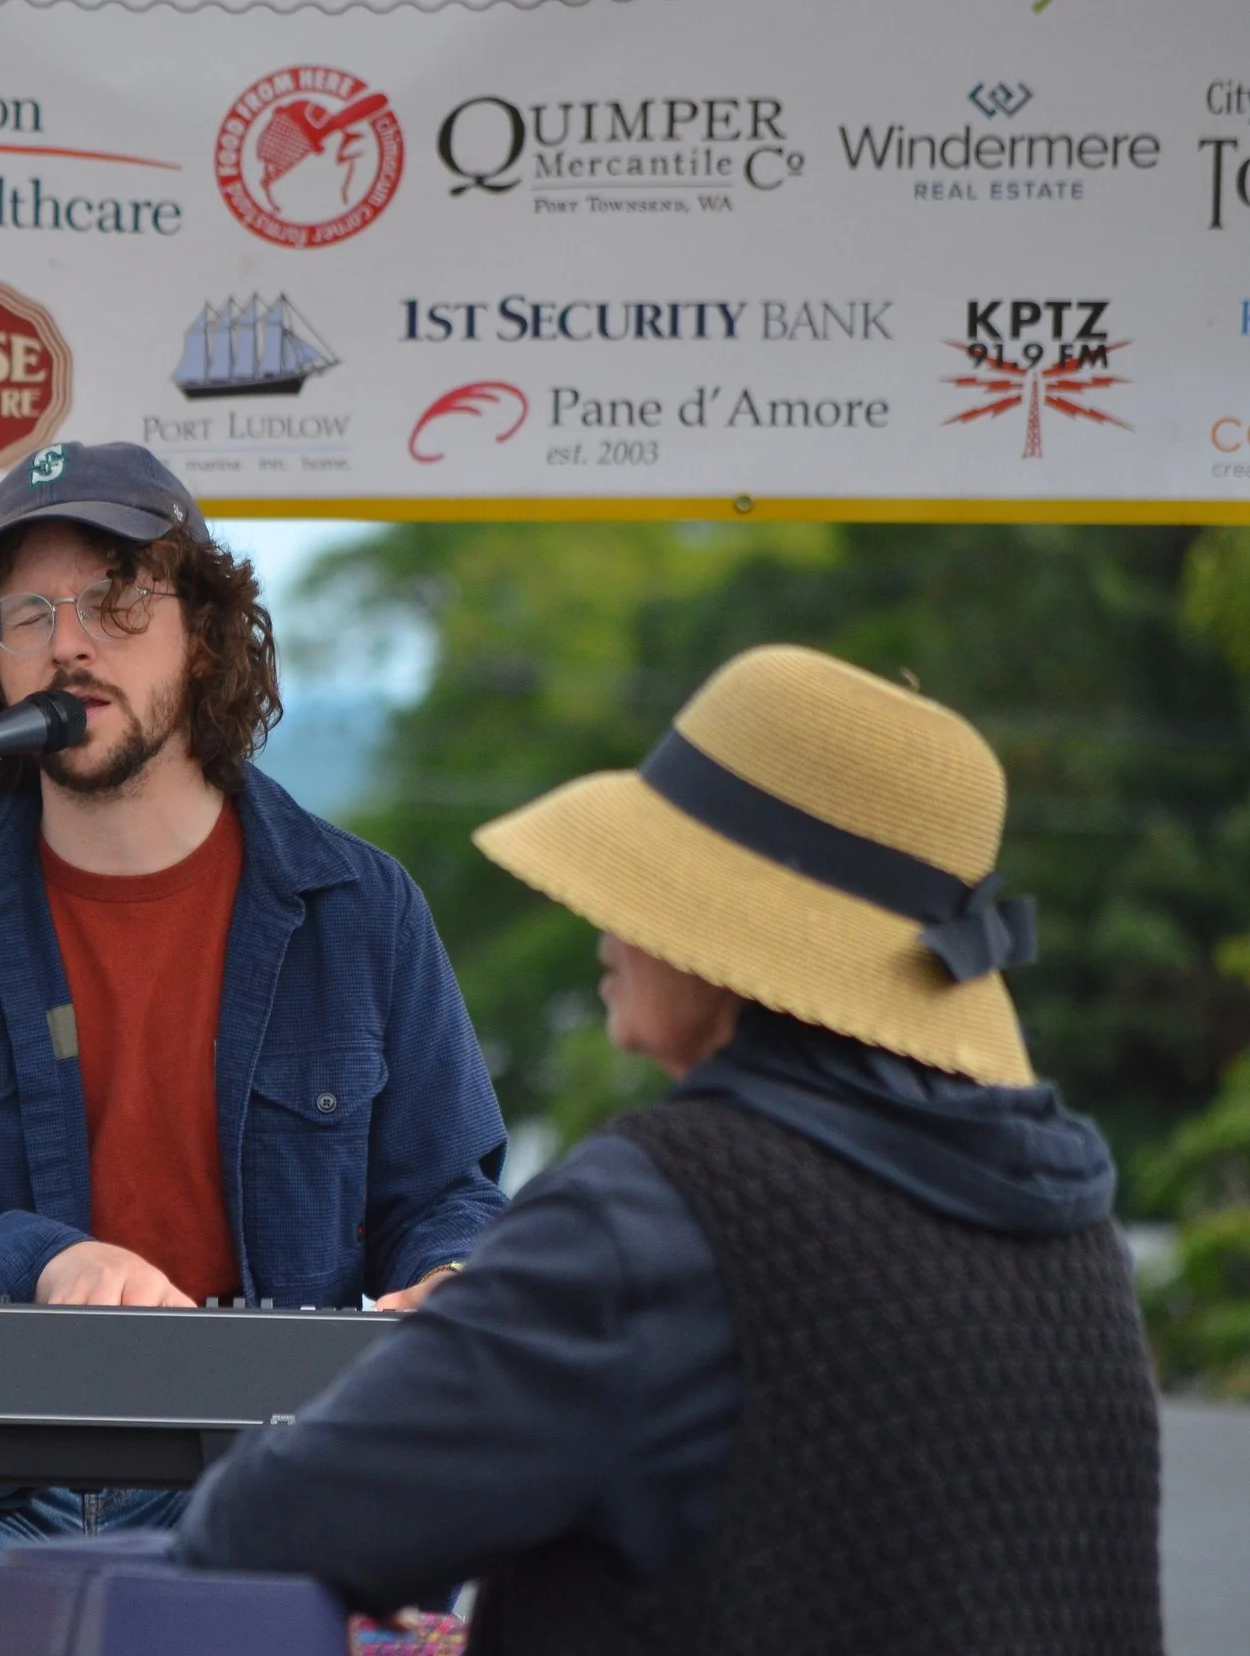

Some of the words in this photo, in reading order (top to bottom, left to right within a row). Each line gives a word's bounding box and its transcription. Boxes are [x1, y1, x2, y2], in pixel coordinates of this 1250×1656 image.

[217, 117, 247, 178] FOOD
[234, 71, 294, 122] FROM
[299, 67, 355, 101] HERE
[437, 96, 786, 197] QUIMPER
[839, 124, 1161, 170] Windermere
[534, 150, 734, 180] Mercantile
[697, 194, 734, 214] WA
[913, 181, 978, 201] REAL
[990, 181, 1084, 201] ESTATE
[496, 294, 748, 343] SECURITY
[760, 301, 894, 342] BANK
[967, 301, 1110, 340] KPTZ
[967, 341, 1044, 370] 91.9
[1058, 343, 1108, 369] FM
[551, 387, 661, 428] Pane
[143, 415, 214, 443] PORT
[228, 412, 351, 441] LUDLOW
[547, 443, 588, 466] est.
[598, 442, 660, 466] 2003
